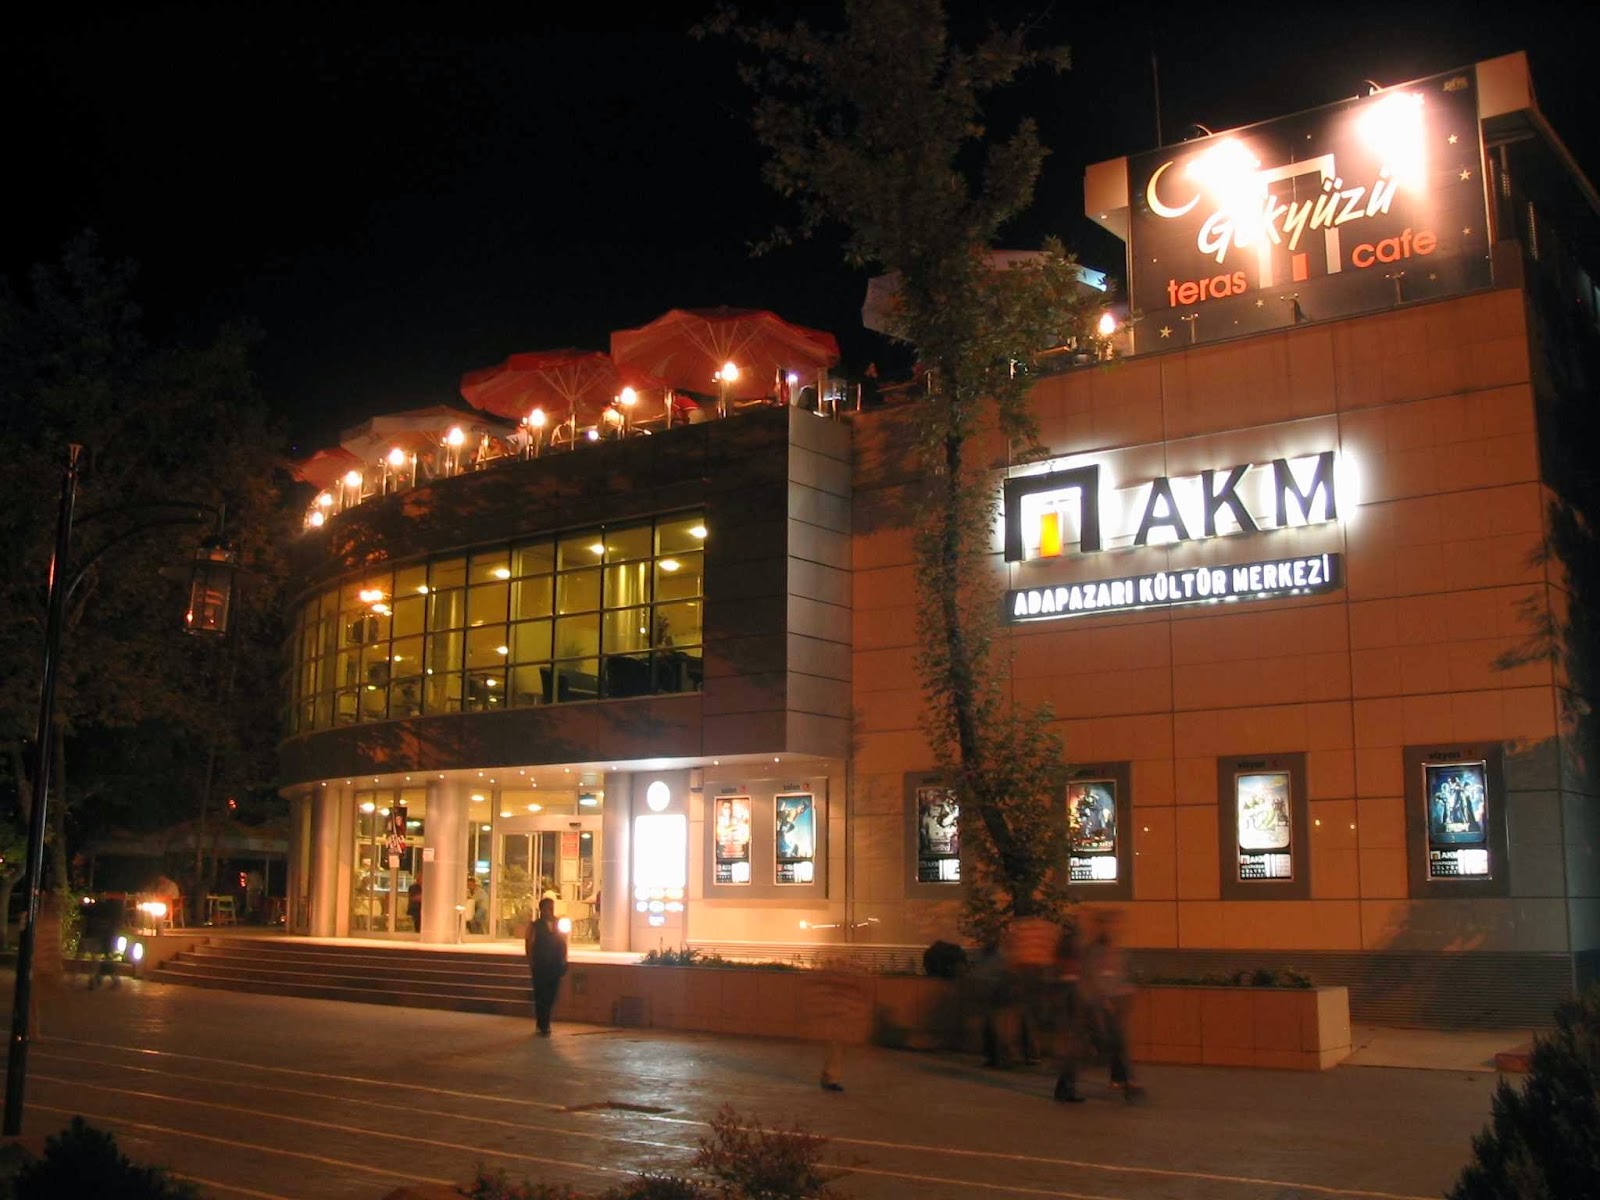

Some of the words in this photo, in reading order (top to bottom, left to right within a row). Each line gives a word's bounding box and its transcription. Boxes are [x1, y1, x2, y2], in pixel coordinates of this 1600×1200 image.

[1167, 268, 1248, 307] teras
[1352, 226, 1437, 268] cafe
[1134, 450, 1337, 546] AKM
[1013, 578, 1134, 616] ADAPAZARI
[1139, 567, 1226, 603] KÜLTÜR
[1232, 553, 1331, 593] MERKEZİ
